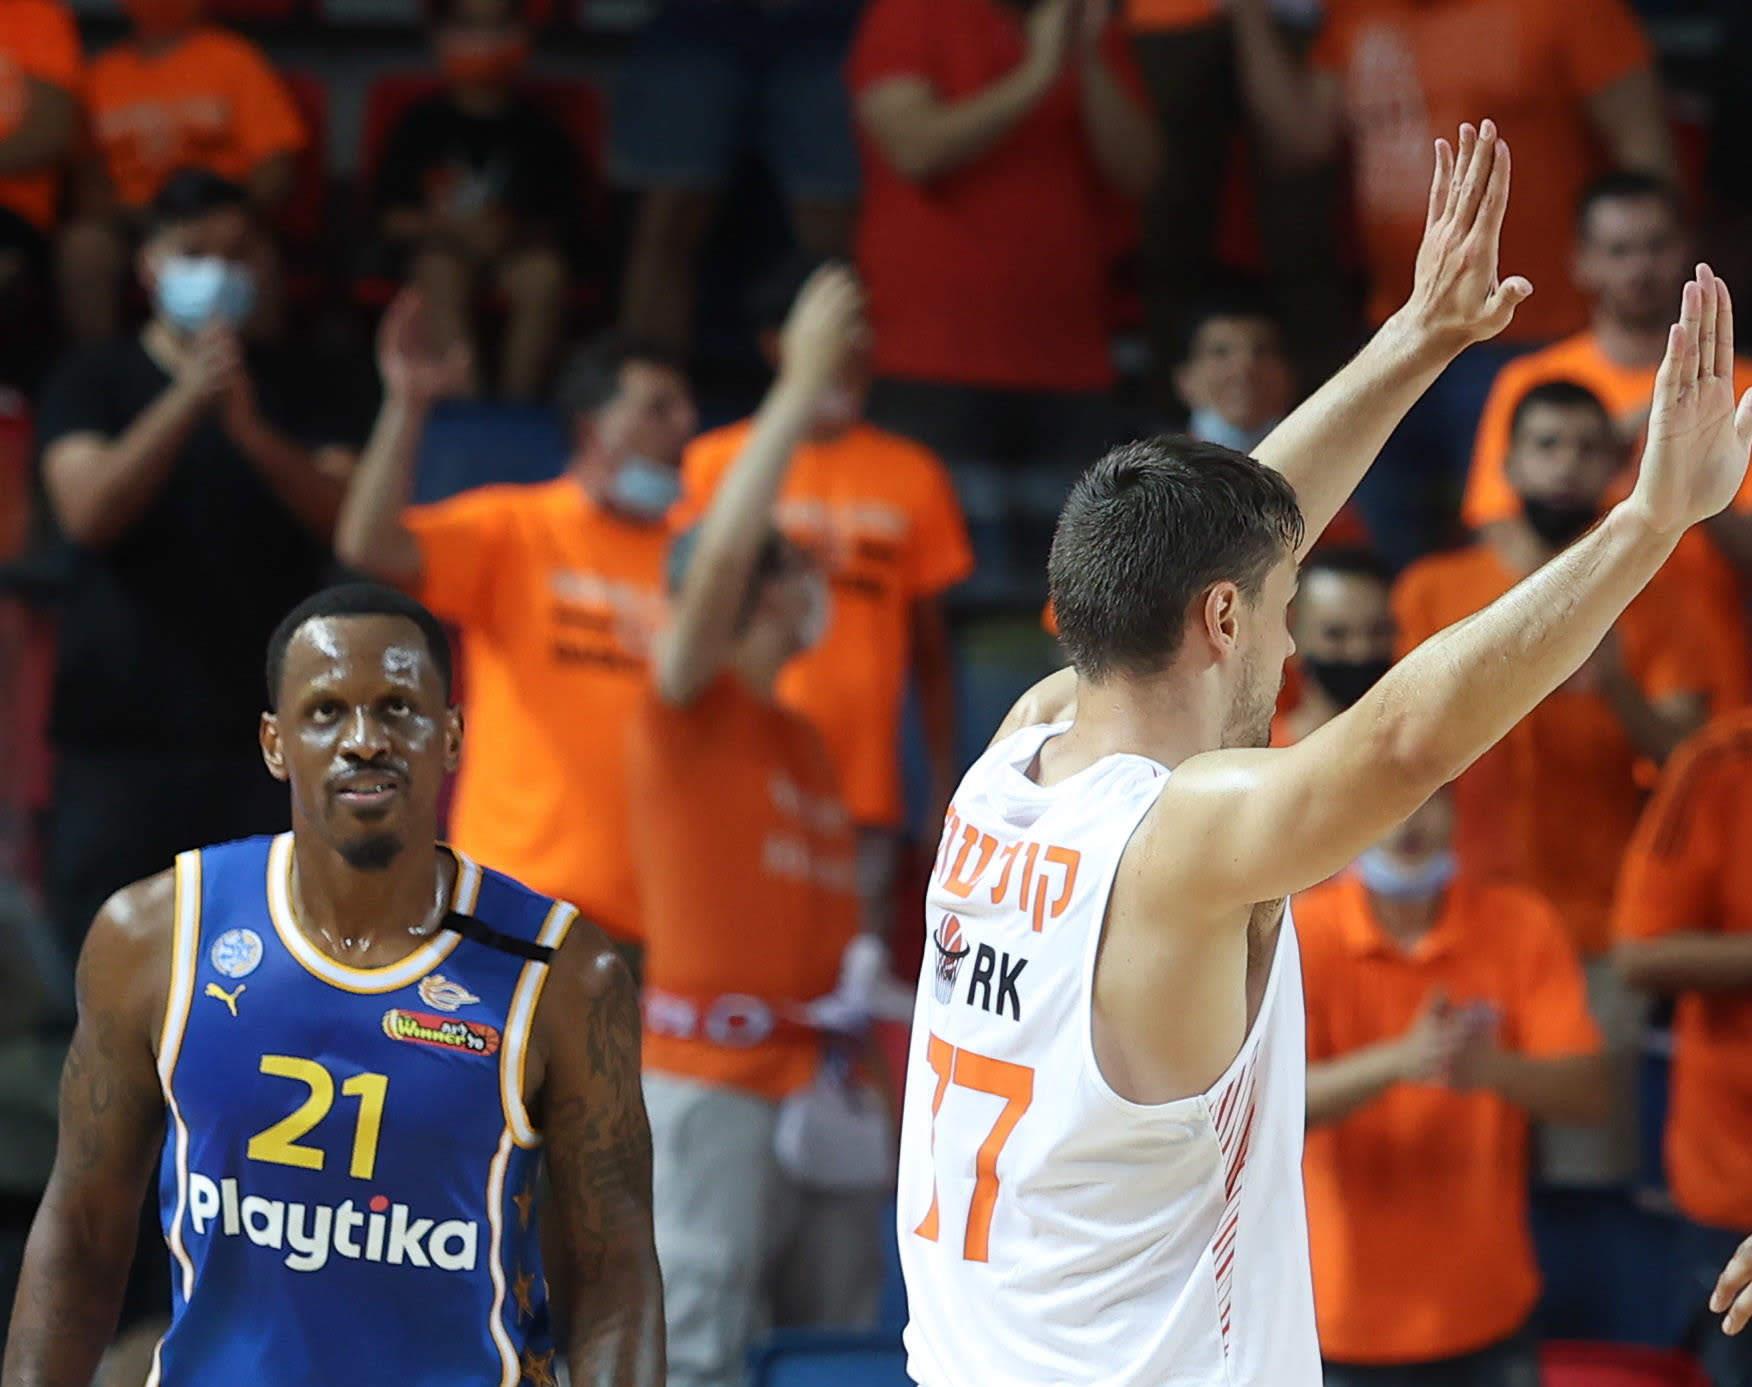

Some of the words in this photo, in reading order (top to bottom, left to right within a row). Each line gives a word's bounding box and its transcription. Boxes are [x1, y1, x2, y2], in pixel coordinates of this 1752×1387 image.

[966, 942, 1029, 1023] RK
[247, 1054, 389, 1181] 21
[913, 1030, 1036, 1263] 77
[188, 1173, 479, 1272] Playtika
